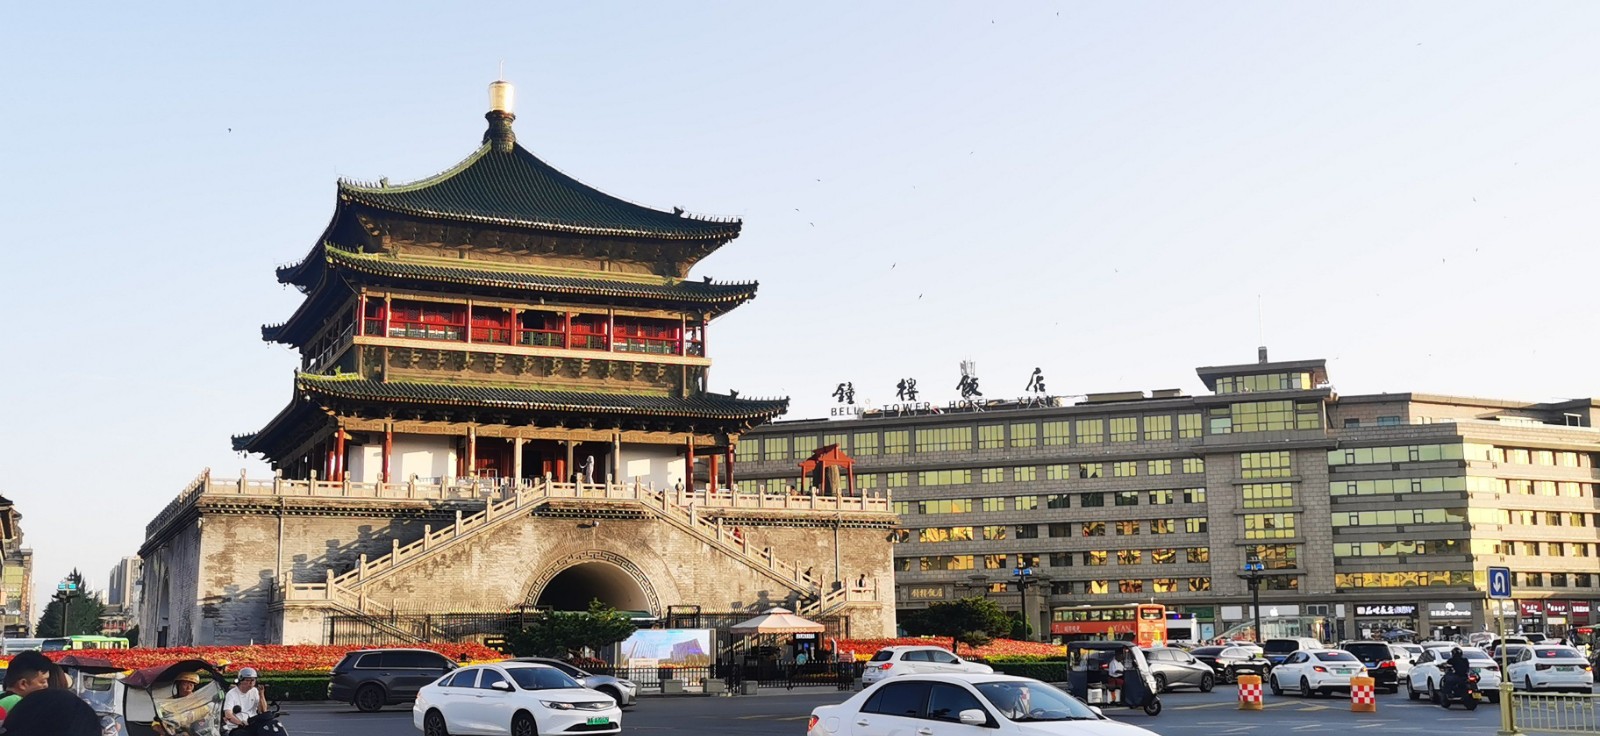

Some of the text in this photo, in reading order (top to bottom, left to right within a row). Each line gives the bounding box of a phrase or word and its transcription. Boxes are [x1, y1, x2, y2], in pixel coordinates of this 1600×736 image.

[831, 406, 859, 416] BELL
[883, 402, 931, 412] TOWER
[949, 398, 988, 408] HOTEL
